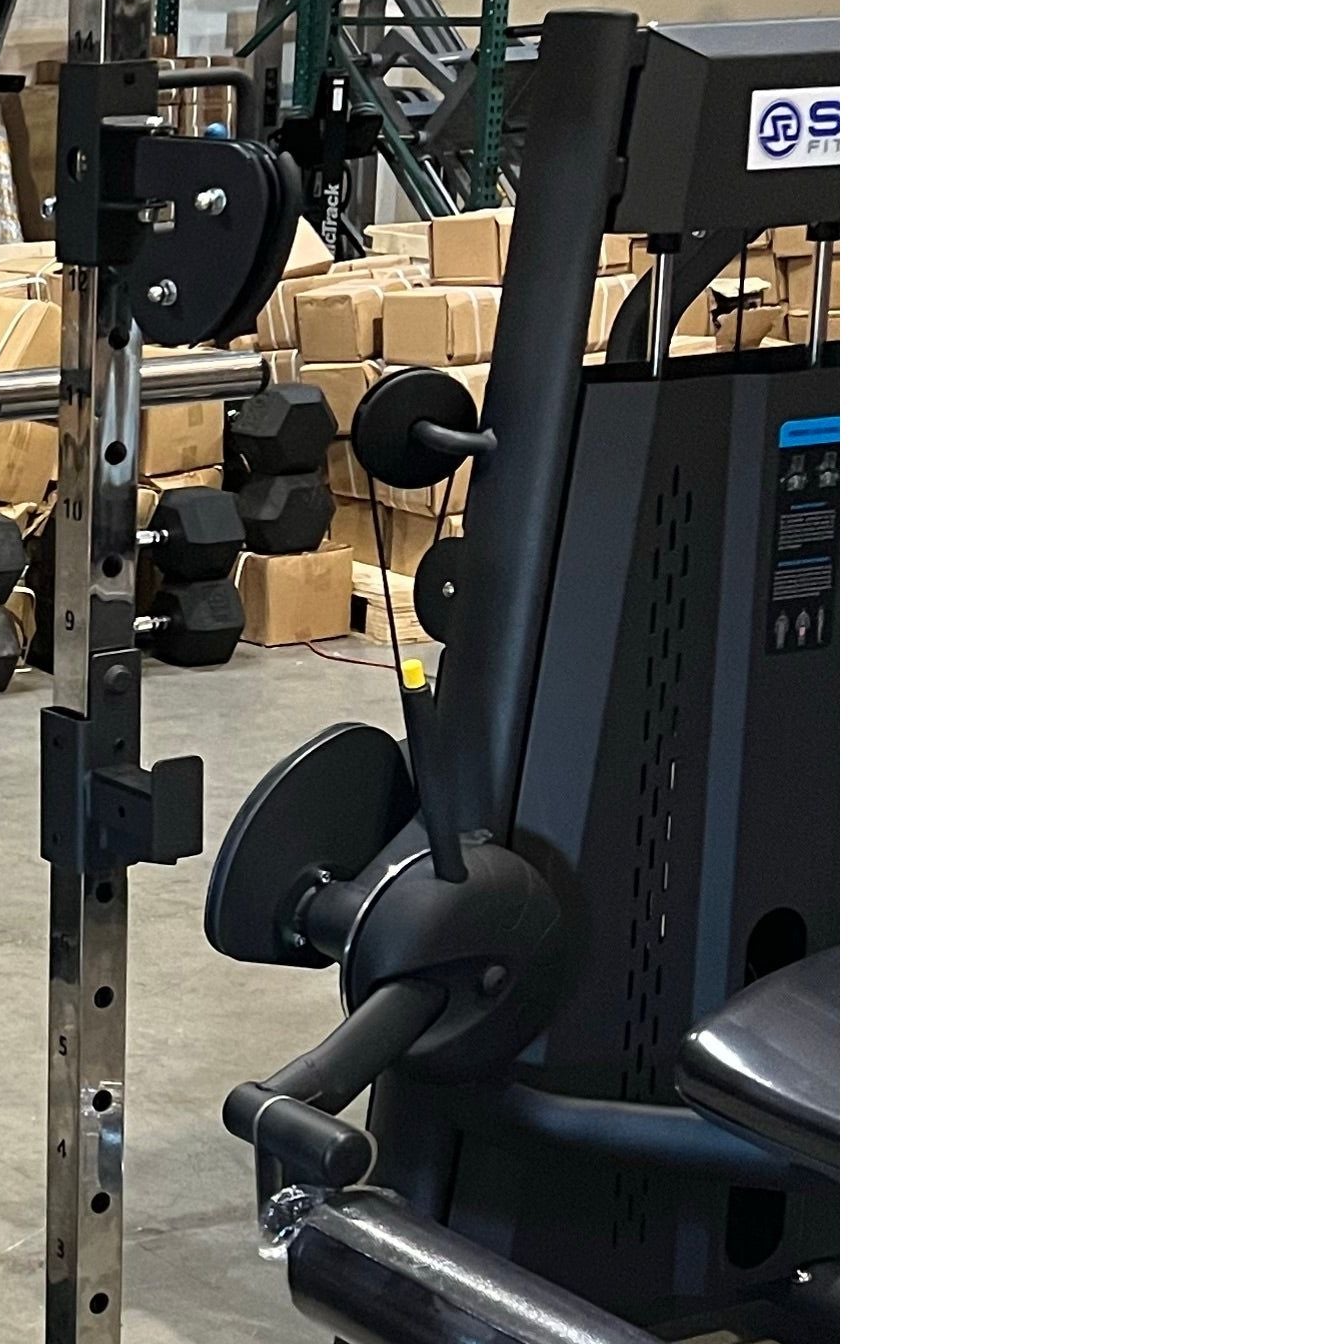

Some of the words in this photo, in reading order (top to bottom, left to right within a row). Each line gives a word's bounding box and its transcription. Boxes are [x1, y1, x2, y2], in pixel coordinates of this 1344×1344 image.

[321, 183, 340, 255] icTrack
[68, 268, 89, 293] 12
[65, 384, 85, 409] 11
[62, 497, 83, 522] 10
[65, 609, 75, 632] 9
[58, 1034, 68, 1057] 5
[56, 1237, 65, 1260] 3
